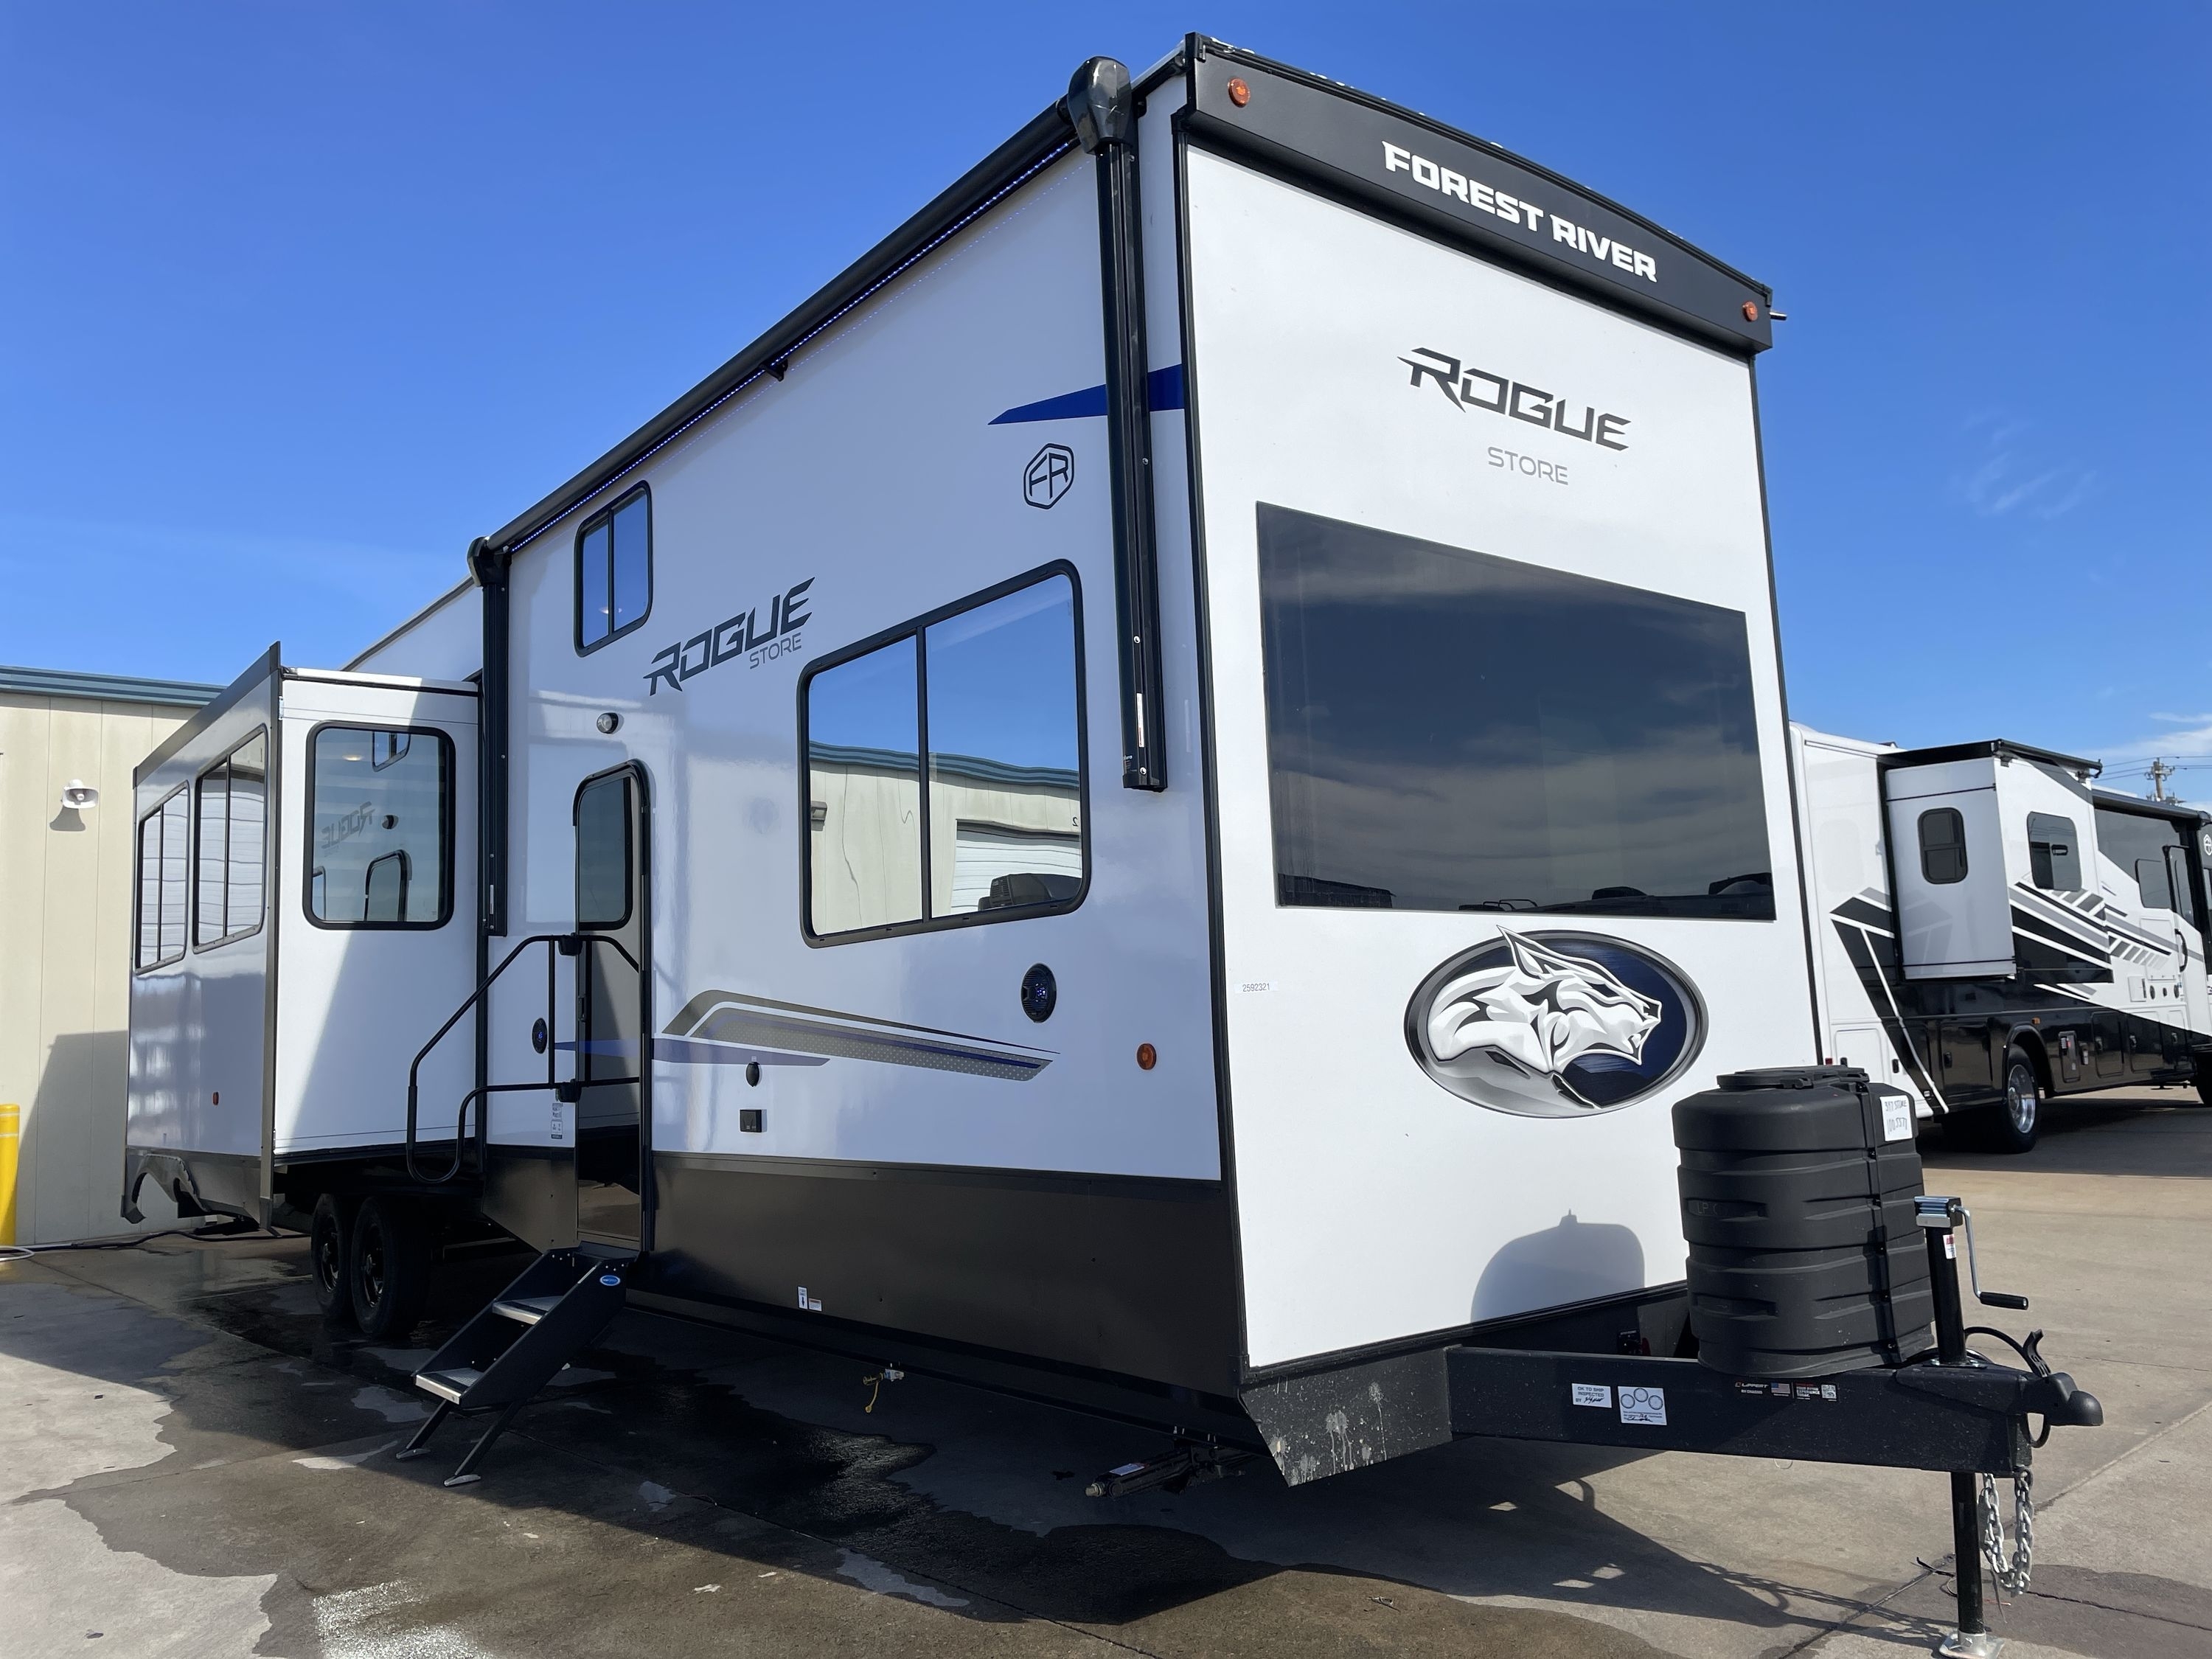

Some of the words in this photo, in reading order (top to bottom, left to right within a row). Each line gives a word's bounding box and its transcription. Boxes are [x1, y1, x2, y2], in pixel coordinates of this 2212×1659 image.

[1382, 140, 1544, 232] FOREST
[1550, 214, 1658, 283] RIVER
[1397, 347, 1632, 451] ROGUE
[1487, 446, 1569, 486] STORE
[643, 577, 815, 697] ROGUE
[749, 632, 802, 670] STORE
[1242, 982, 1270, 992] 2592321
